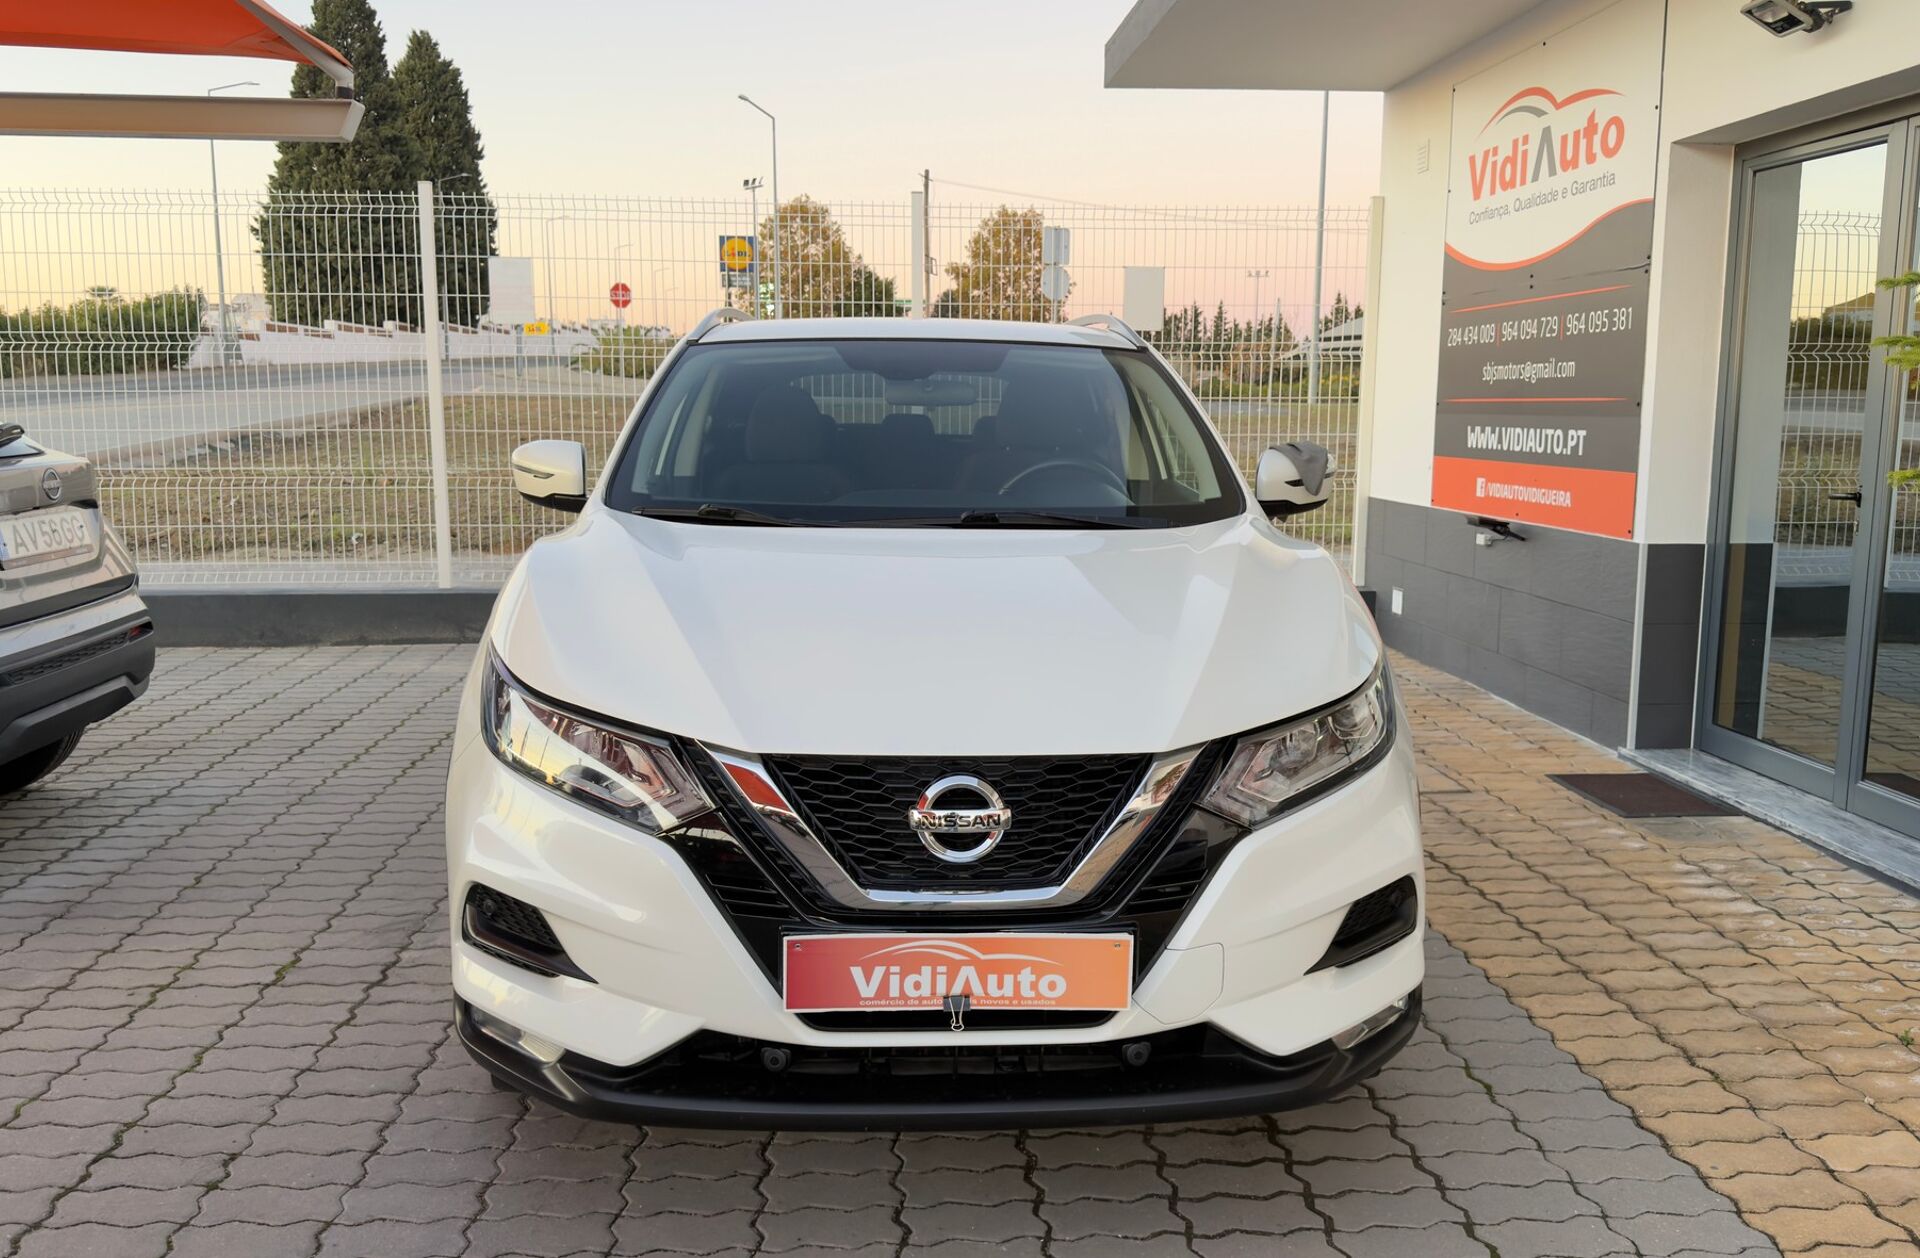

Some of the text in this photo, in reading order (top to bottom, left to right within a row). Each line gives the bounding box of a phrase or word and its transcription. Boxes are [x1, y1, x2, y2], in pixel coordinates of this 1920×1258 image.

[1469, 109, 1625, 201] VidiAuto
[1469, 171, 1616, 225] Confiança, Qualidade e Garantia
[1447, 307, 1633, 347] 284 434 009 964 094 729 964 095 381
[1482, 358, 1575, 385] sbjsmotors@gmail.com
[1467, 425, 1587, 456] WWW.VIDIAUTO.PT
[921, 813, 1000, 828] NISSAN
[849, 965, 1067, 998] VidiAuto
[860, 998, 904, 1006] comércio
